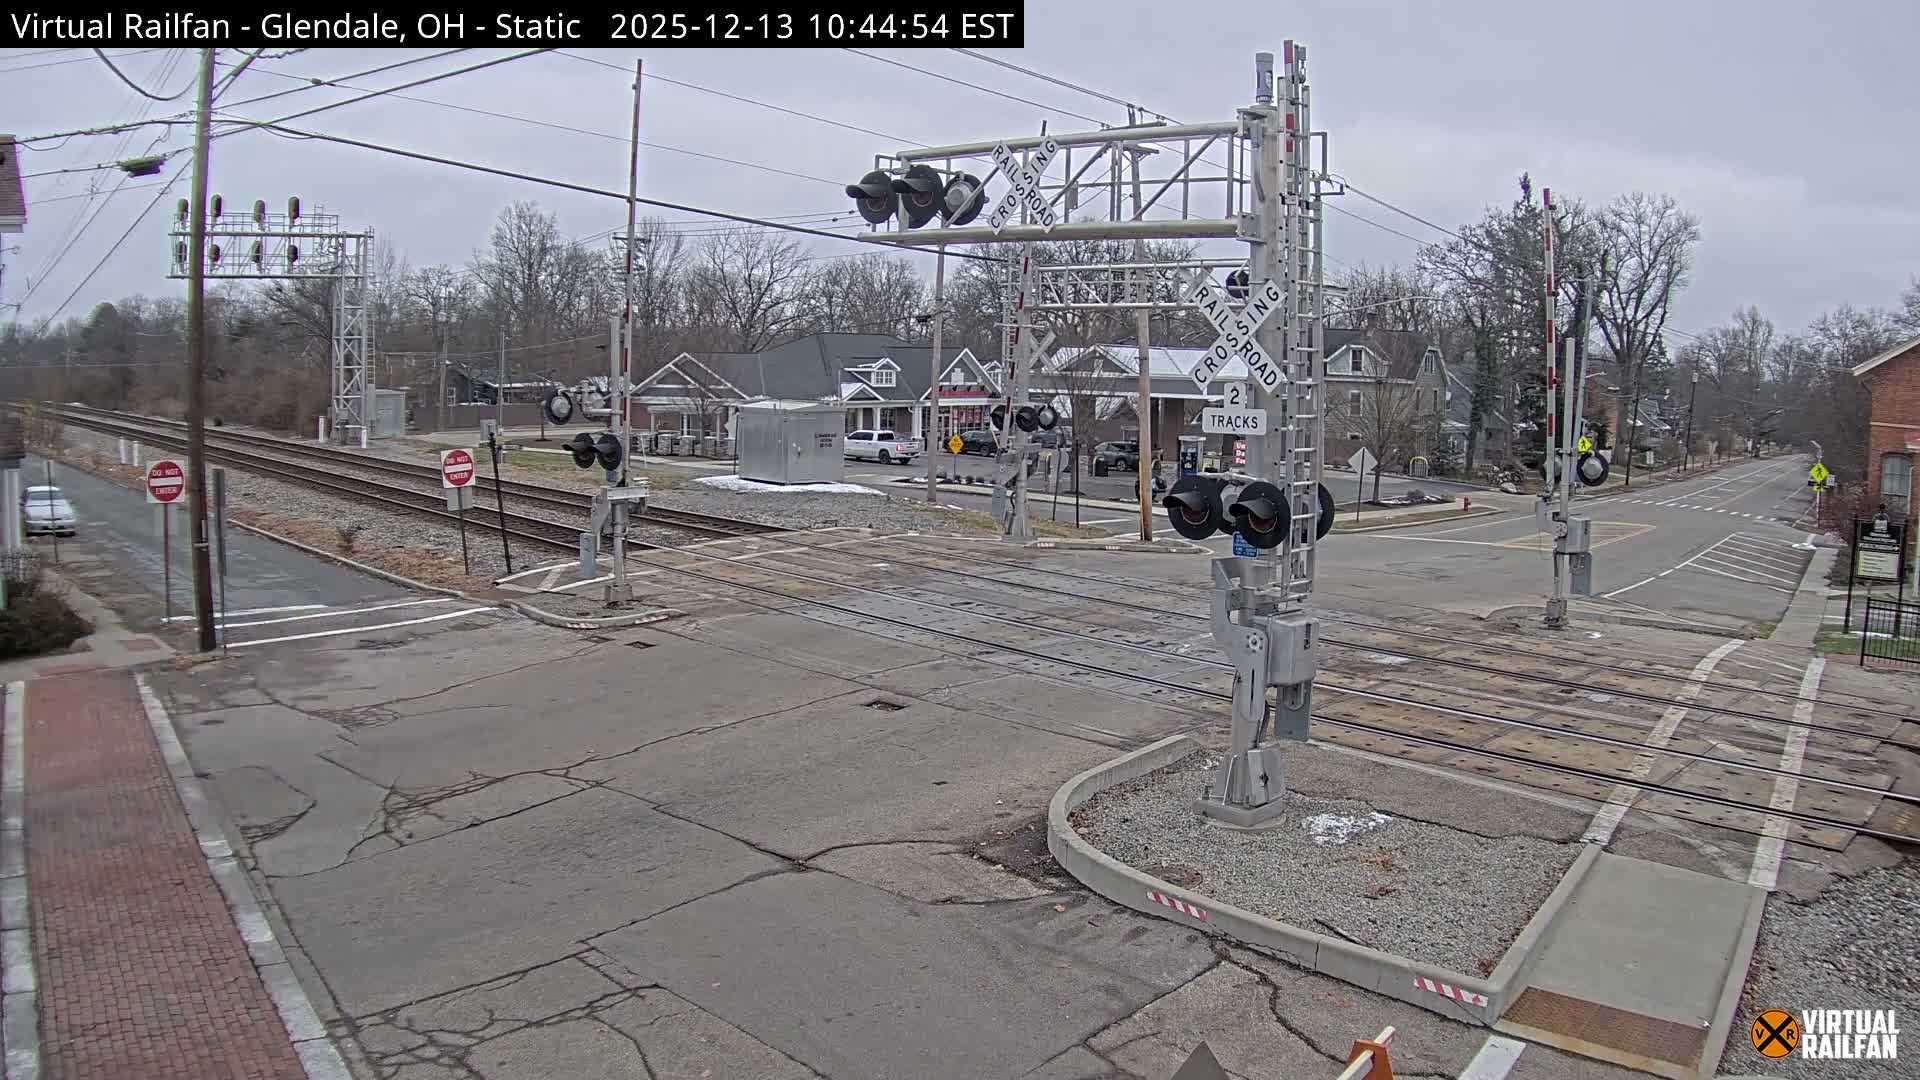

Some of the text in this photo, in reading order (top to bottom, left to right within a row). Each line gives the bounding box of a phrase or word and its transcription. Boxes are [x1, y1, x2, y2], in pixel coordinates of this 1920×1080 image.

[990, 140, 1055, 229] CROSSING
[1194, 286, 1279, 384] CROSSING
[1230, 387, 1240, 405] 2
[1211, 414, 1258, 429] TRACKS
[151, 468, 179, 477] DO NOT
